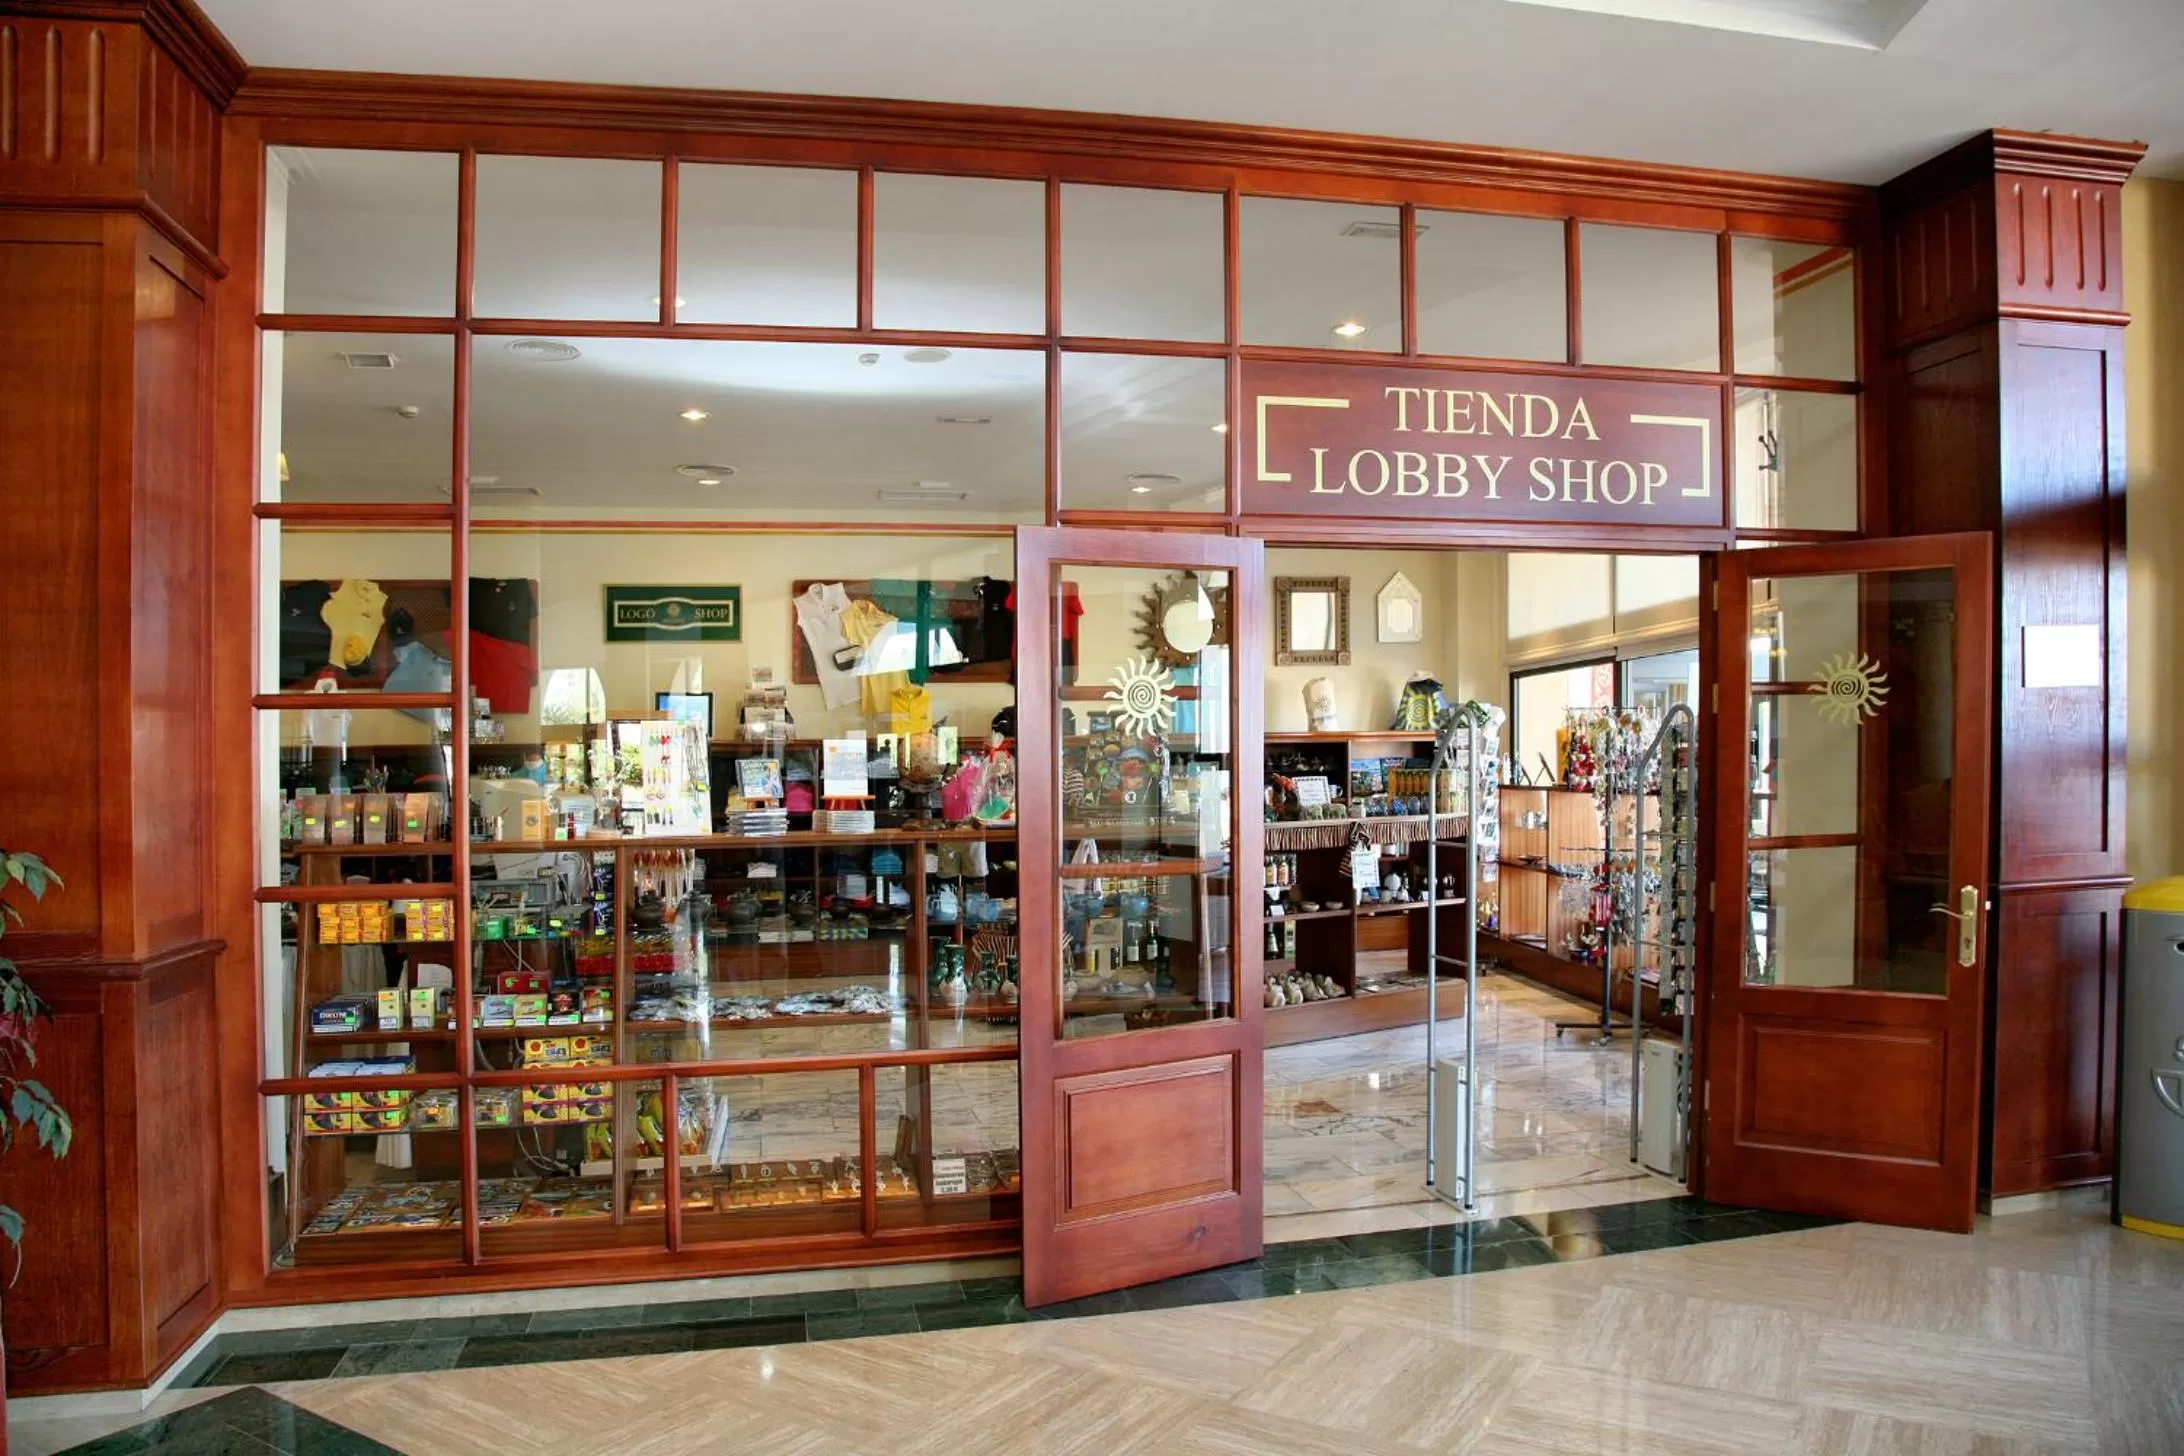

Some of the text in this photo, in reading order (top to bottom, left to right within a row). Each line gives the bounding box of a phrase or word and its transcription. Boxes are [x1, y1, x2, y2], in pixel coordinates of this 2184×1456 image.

[1385, 387, 1600, 441] TIENDA
[1309, 447, 1669, 505] LOBBY SHOP
[620, 607, 728, 619] LOGO SHOP
